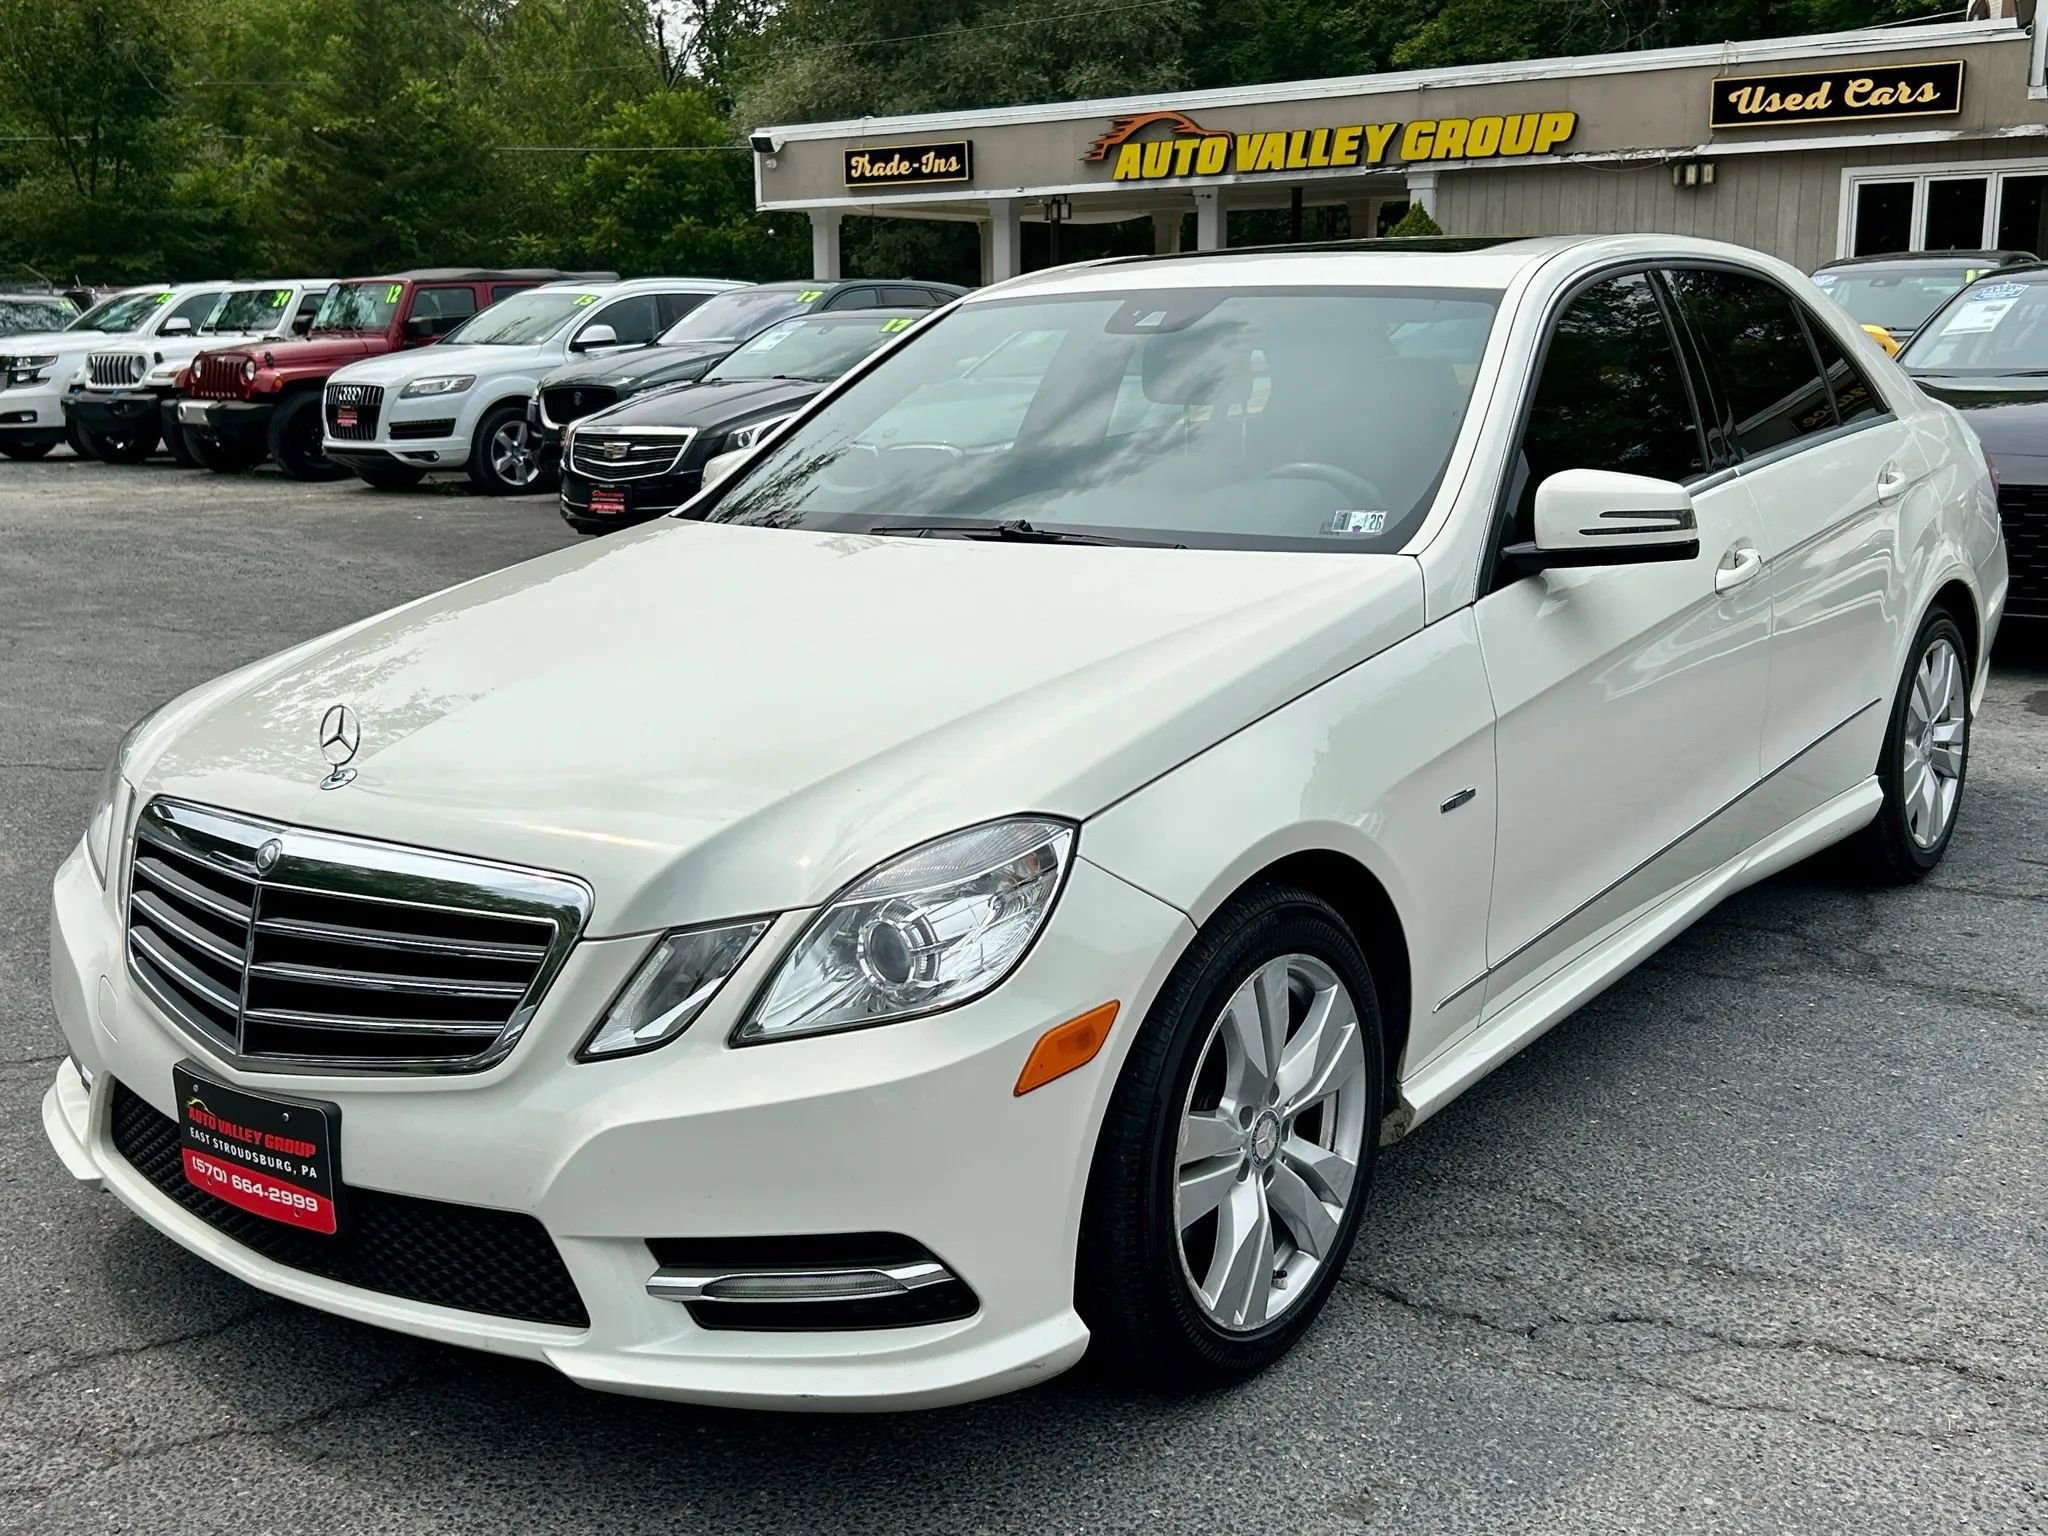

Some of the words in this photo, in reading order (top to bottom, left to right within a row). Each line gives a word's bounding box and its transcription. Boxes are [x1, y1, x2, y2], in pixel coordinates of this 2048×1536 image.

[1728, 81, 1832, 114] Used
[1844, 78, 1941, 107] Cars
[1113, 136, 1229, 180] AUTO
[1236, 122, 1399, 171] VALLEY
[1400, 111, 1576, 161] GROUP
[851, 151, 961, 178] Trade-Ins
[386, 285, 402, 304] 12
[573, 294, 598, 306] 15
[796, 291, 823, 302] 17
[880, 319, 913, 332] 17
[1369, 514, 1383, 530] 26
[188, 1105, 216, 1130] AUTO
[218, 1117, 262, 1145] VALLEY
[264, 1134, 316, 1158] GROUP
[190, 1127, 210, 1145] EAST
[212, 1137, 297, 1175] STROUDSBURG,
[301, 1164, 317, 1179] PA
[192, 1156, 227, 1183] (570)
